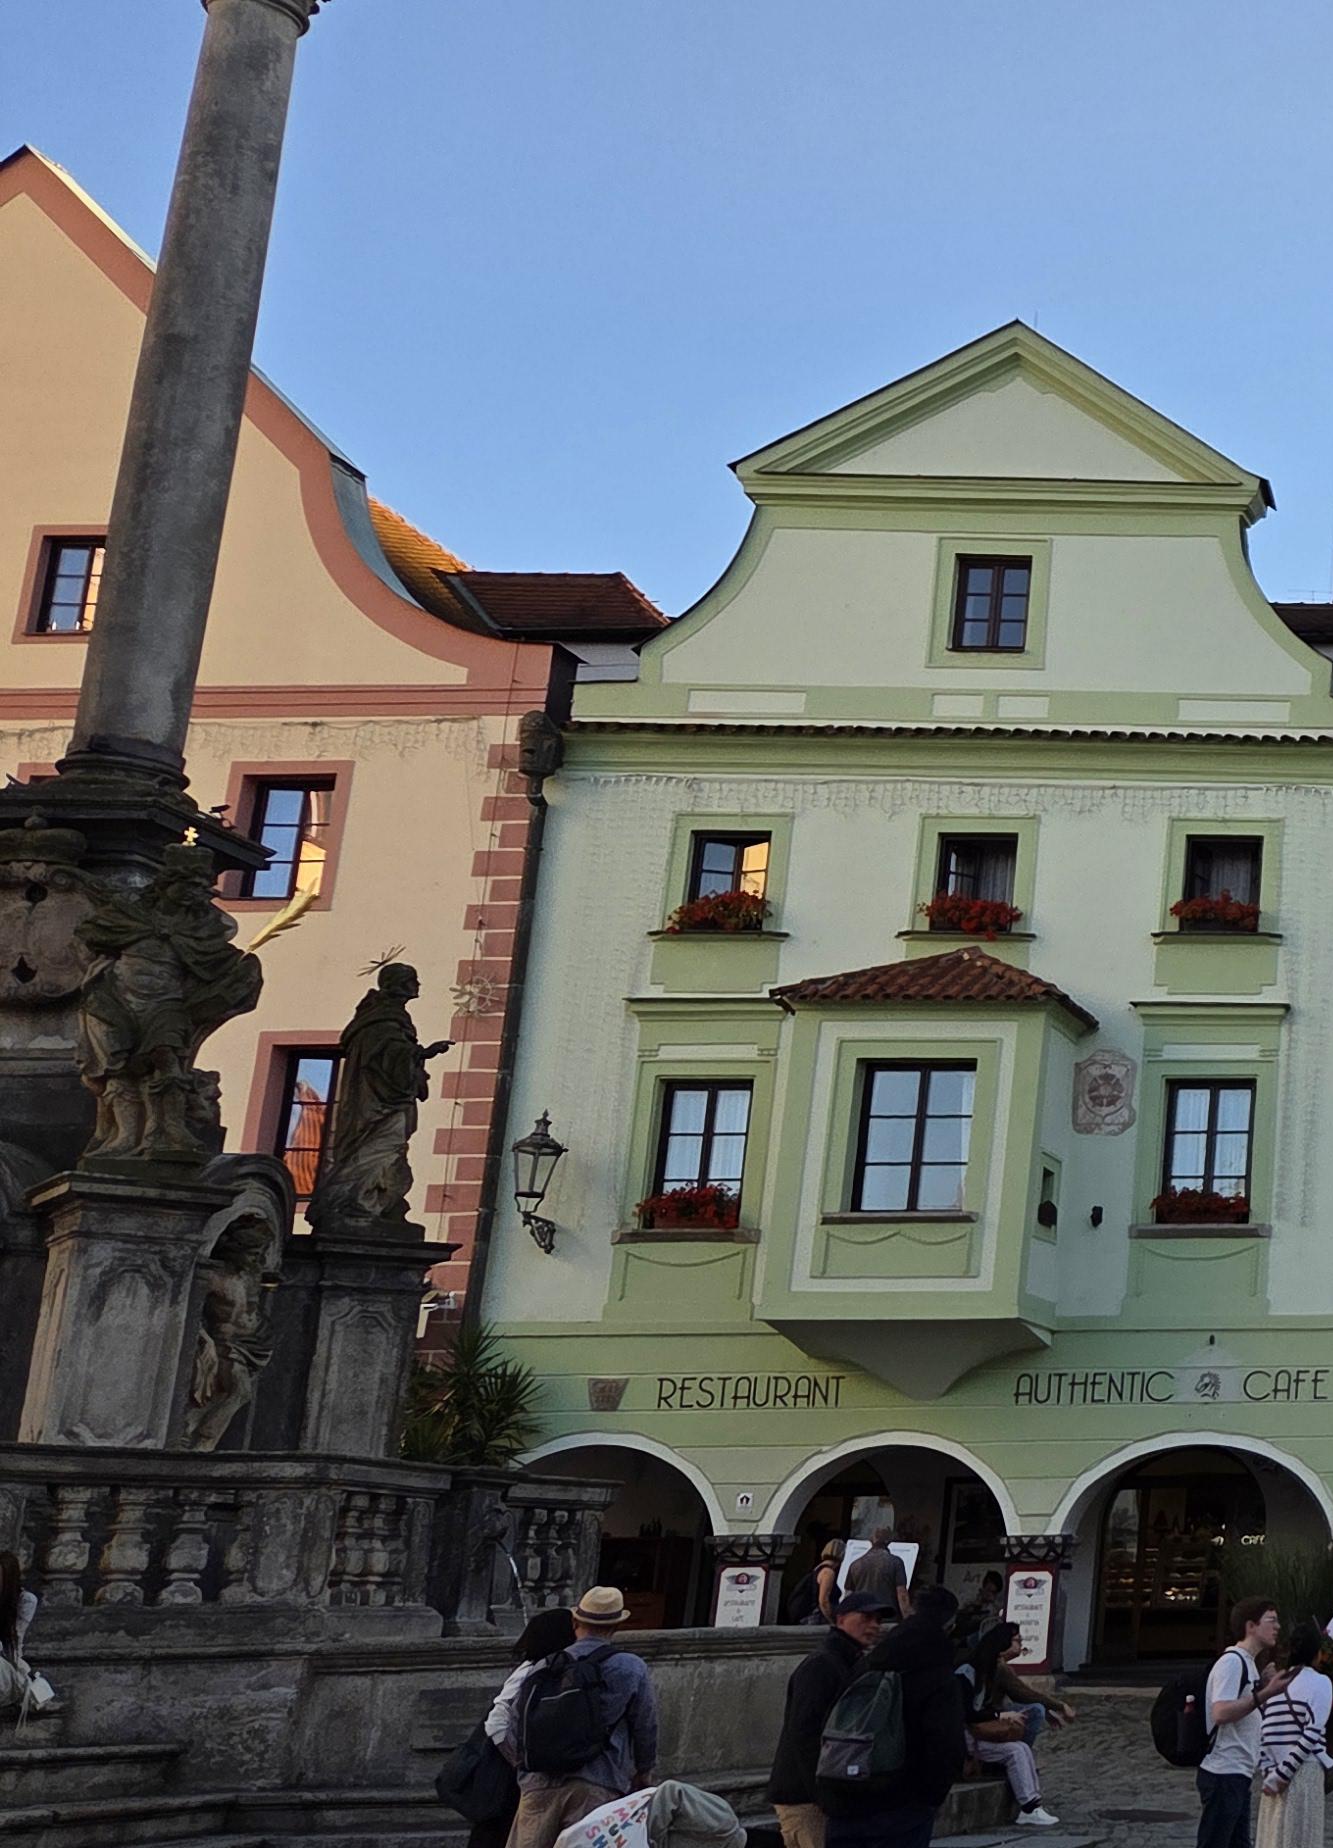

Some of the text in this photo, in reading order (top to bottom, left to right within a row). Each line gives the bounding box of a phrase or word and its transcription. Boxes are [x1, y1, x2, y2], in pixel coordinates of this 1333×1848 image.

[656, 1375, 846, 1409] RESTAURANT
[1013, 1369, 1331, 1406] AUTHENTIC CAFE
